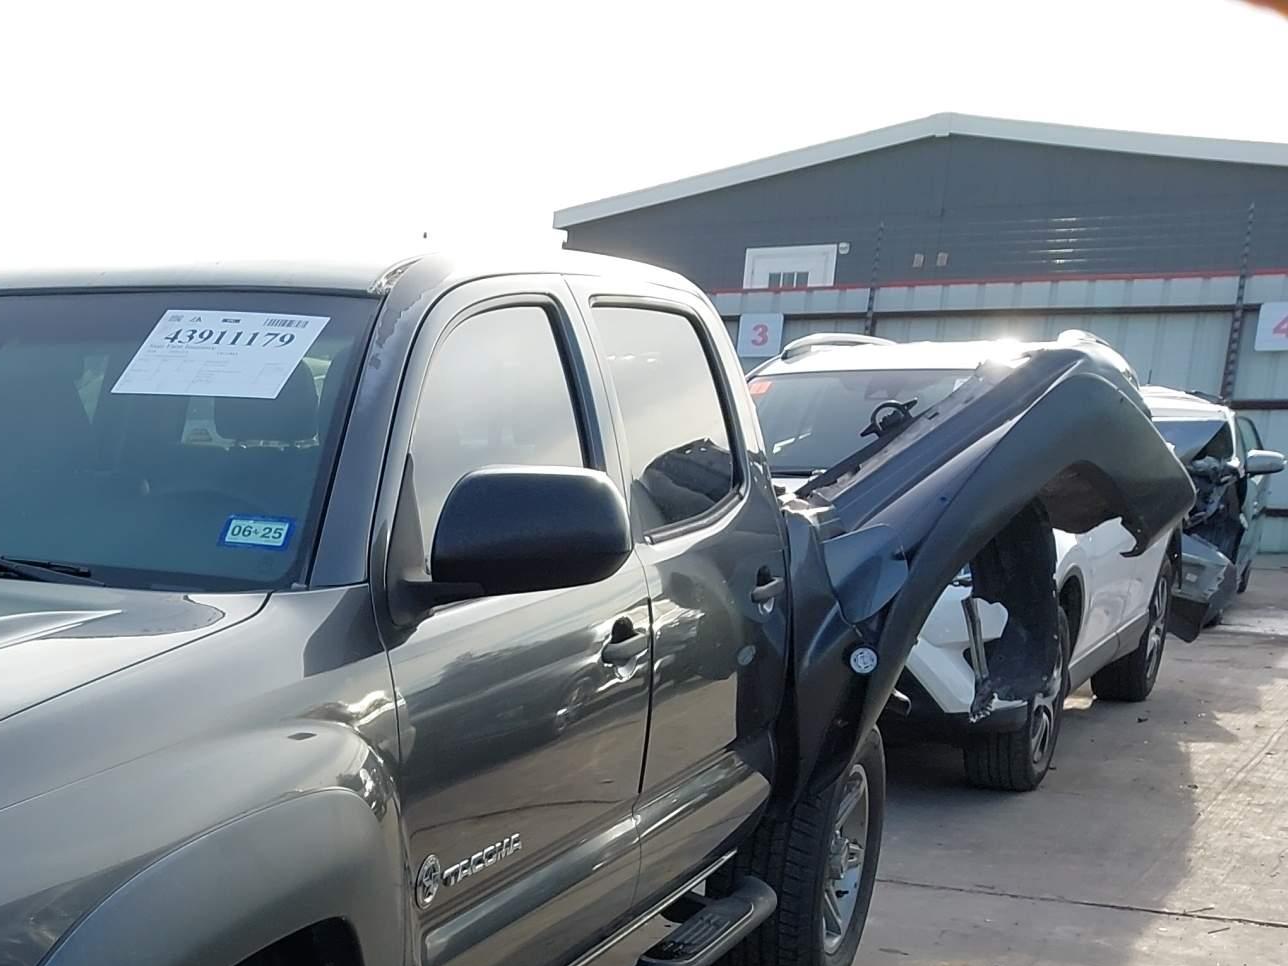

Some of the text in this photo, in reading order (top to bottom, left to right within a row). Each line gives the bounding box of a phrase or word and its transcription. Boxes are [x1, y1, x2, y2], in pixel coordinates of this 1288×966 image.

[164, 328, 296, 348] 43911179
[751, 324, 769, 346] 3
[231, 525, 284, 539] 06 25
[442, 833, 522, 887] TACOMA
